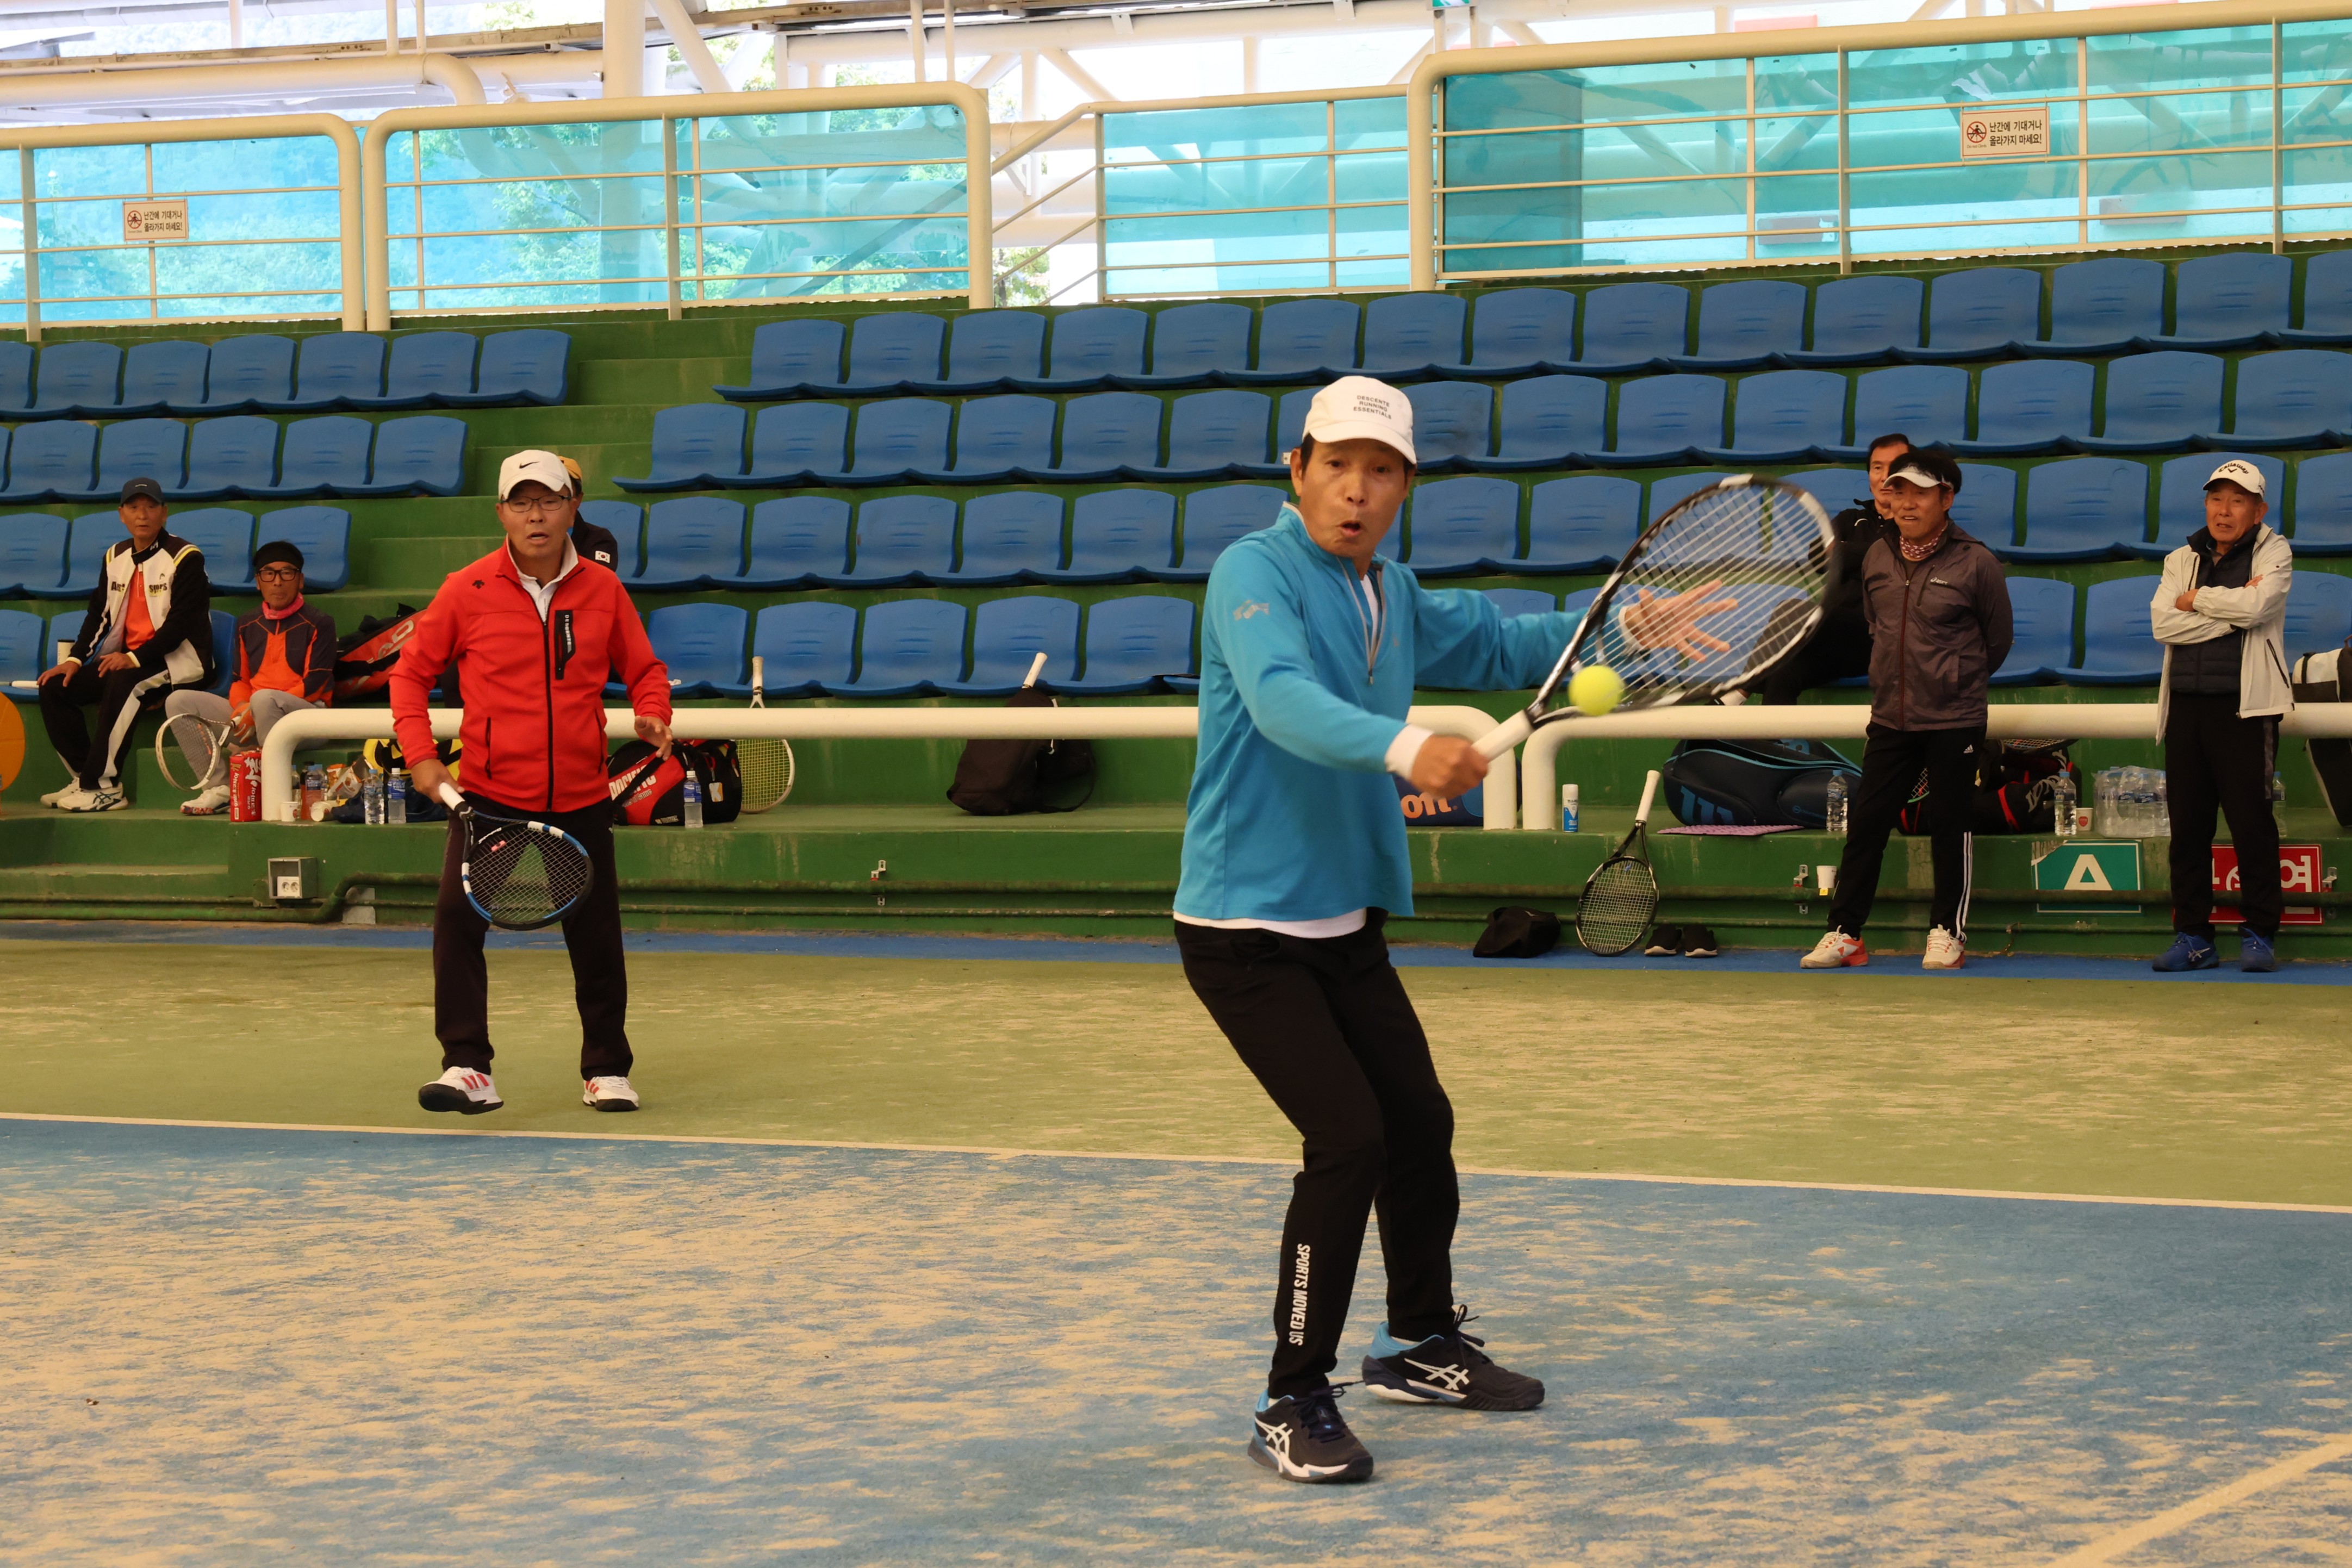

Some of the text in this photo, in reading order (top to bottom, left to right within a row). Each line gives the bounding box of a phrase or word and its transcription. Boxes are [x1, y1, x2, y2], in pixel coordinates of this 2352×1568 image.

[1989, 120, 2042, 132] 난간에 기대거나
[1989, 134, 2042, 146] 올라가지 마세요!
[144, 210, 182, 220] 난간에 기대거나
[144, 222, 164, 232] 올라가지
[165, 222, 183, 231] 마세요!
[1357, 395, 1390, 407] DESCENTE
[1359, 401, 1387, 412] RUNNING
[1353, 406, 1391, 419] ESSENTIALS
[2219, 463, 2249, 474] Callaway
[2064, 854, 2113, 891] A
[1289, 1243, 1311, 1346] SPORTS MOVED US
